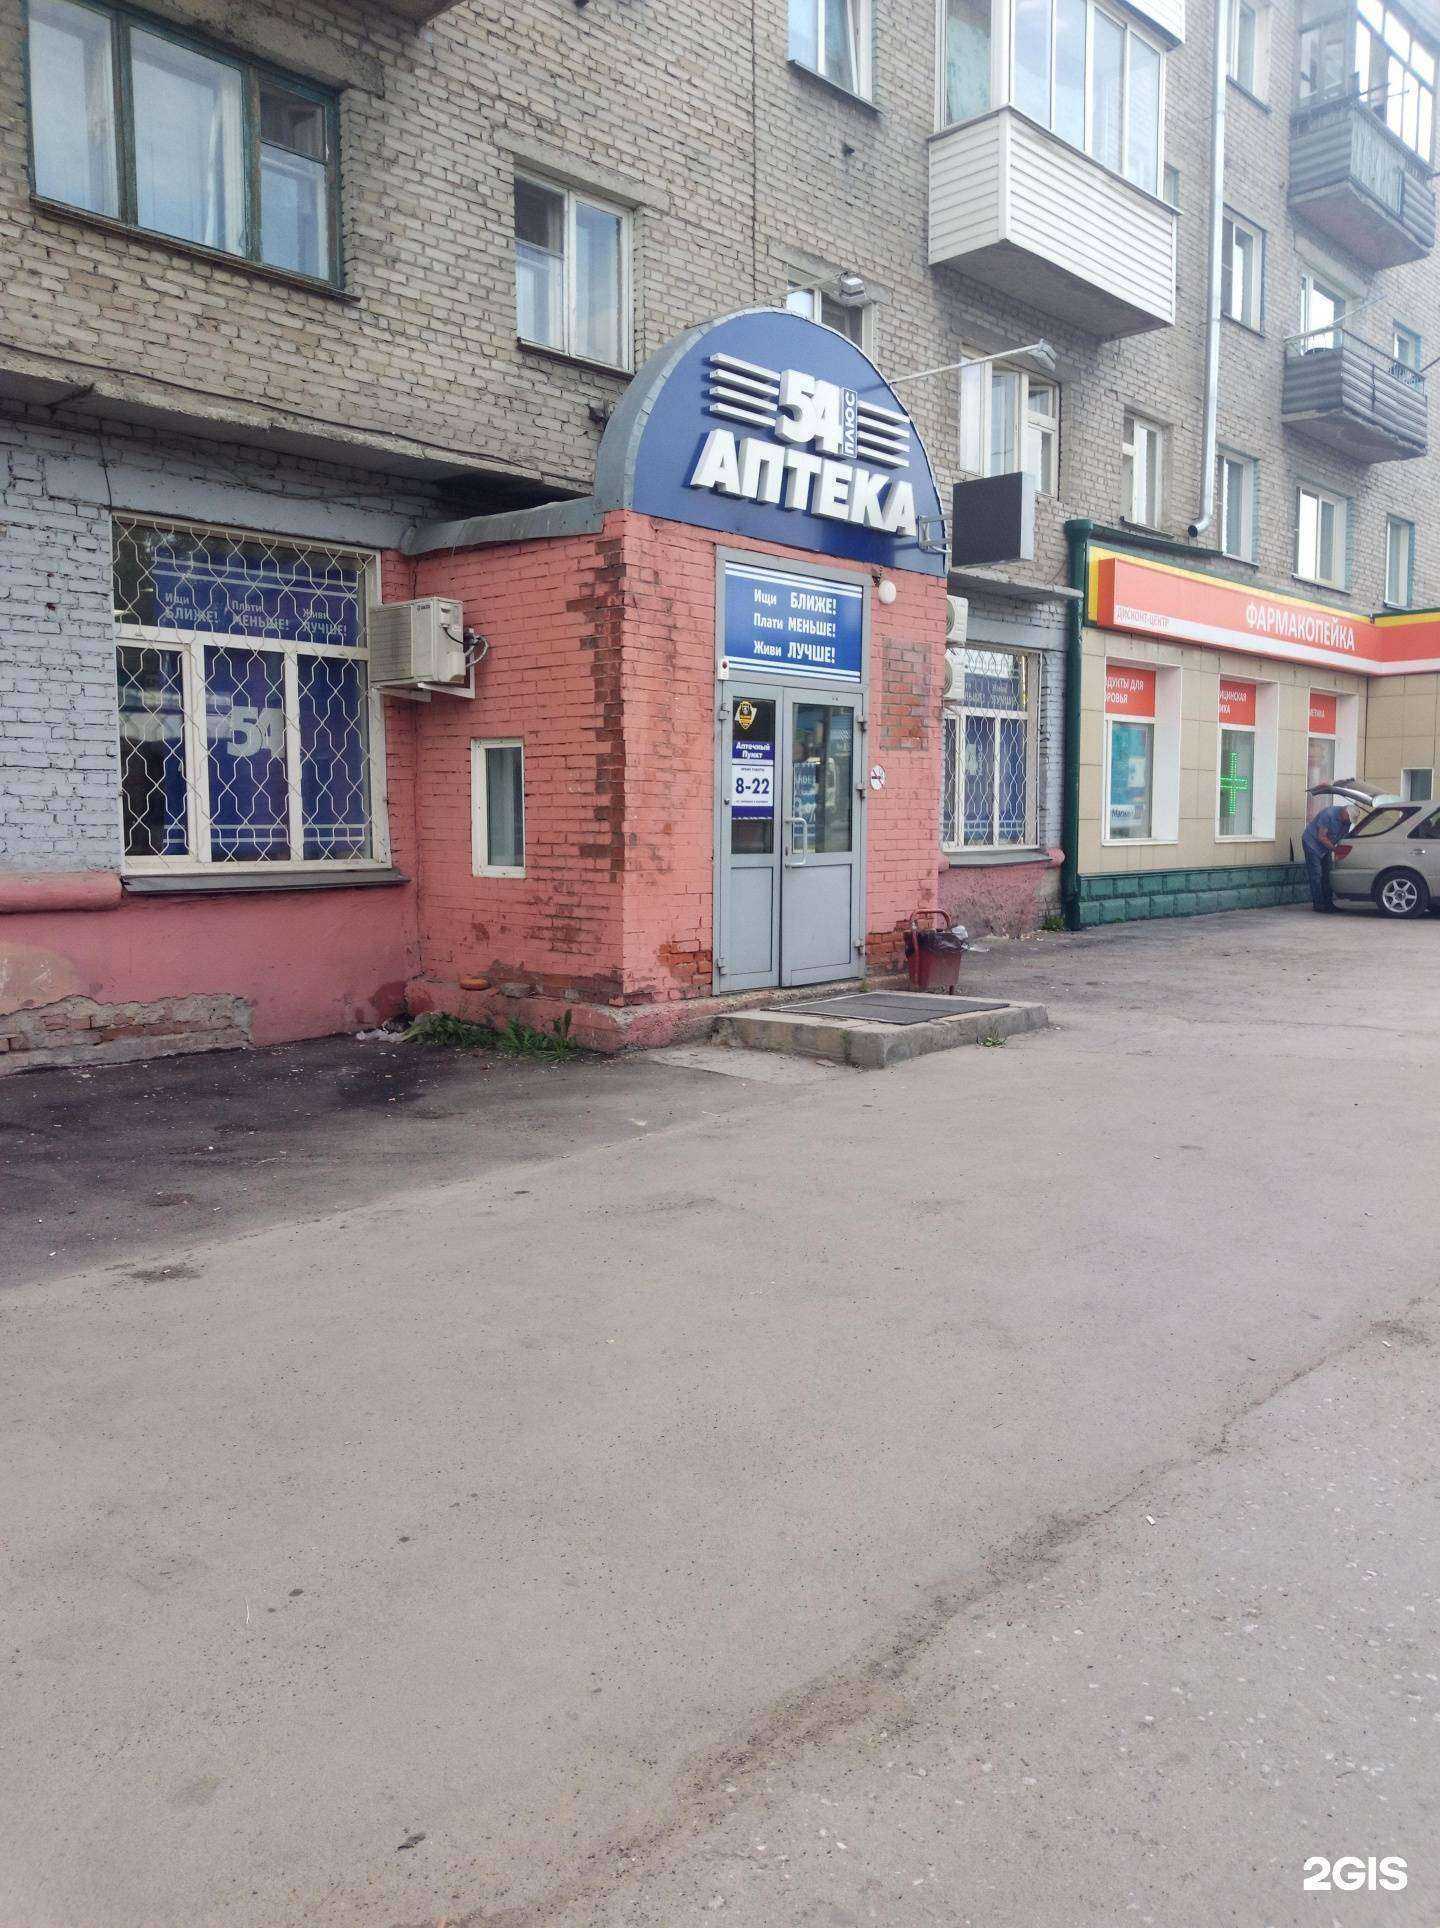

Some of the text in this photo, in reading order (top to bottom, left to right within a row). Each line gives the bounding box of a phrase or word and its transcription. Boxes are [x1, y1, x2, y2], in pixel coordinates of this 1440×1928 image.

[775, 369, 842, 454] 54
[845, 390, 856, 455] ПЛЮС
[690, 428, 917, 537] АПТЕКА
[754, 588, 837, 615] Ищи БЛИЖЕ!
[753, 612, 836, 638] Плати МЕНЬШЕ!
[1246, 601, 1356, 652] ФАРМАКОПЕЙКА
[753, 640, 836, 664] Живи ЛУЧШЕ!
[1105, 676, 1130, 690] ДУКТЫ
[227, 706, 286, 758] 54
[742, 750, 764, 759] Пункт
[735, 777, 770, 794] 8-22
